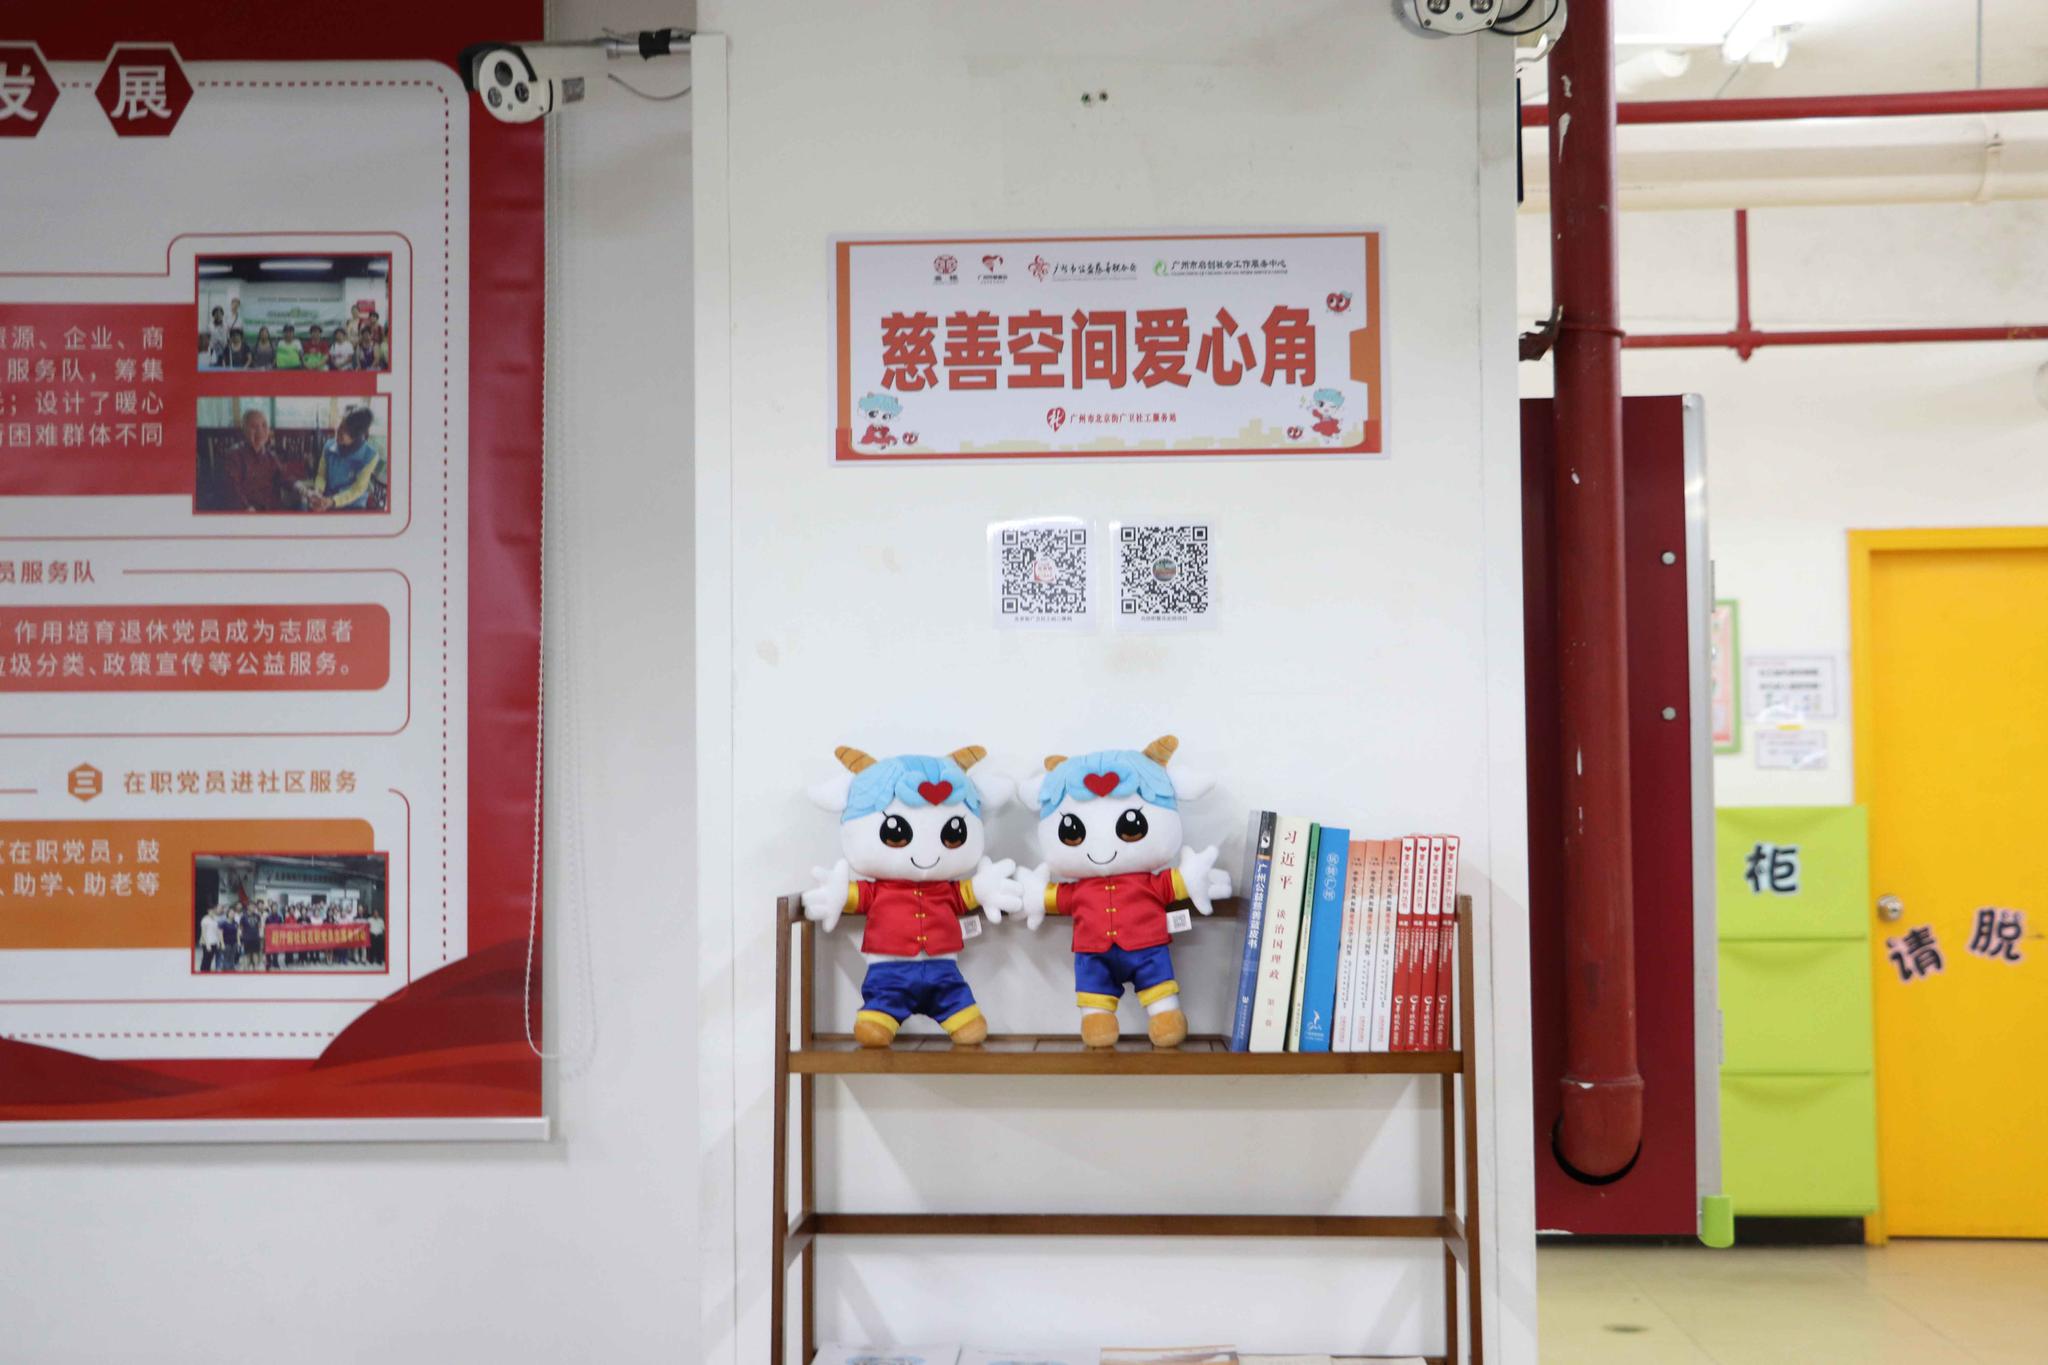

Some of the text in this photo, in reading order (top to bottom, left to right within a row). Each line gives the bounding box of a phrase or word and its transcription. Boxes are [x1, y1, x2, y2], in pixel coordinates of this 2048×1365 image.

[0, 325, 164, 351] 源、企业、商
[880, 305, 1316, 392] 慈善空间爱心角
[0, 390, 164, 416] ；设计了暖心
[0, 422, 164, 448] 困难群体不同
[15, 618, 353, 645] 作用培育退休党员成为志愿者
[0, 650, 350, 677] 圾分类、政策宣传等公益服务。
[123, 769, 358, 795] 在职党员进社区服务
[0, 838, 160, 864] 在职党员，鼓
[1746, 844, 1797, 892] 柜
